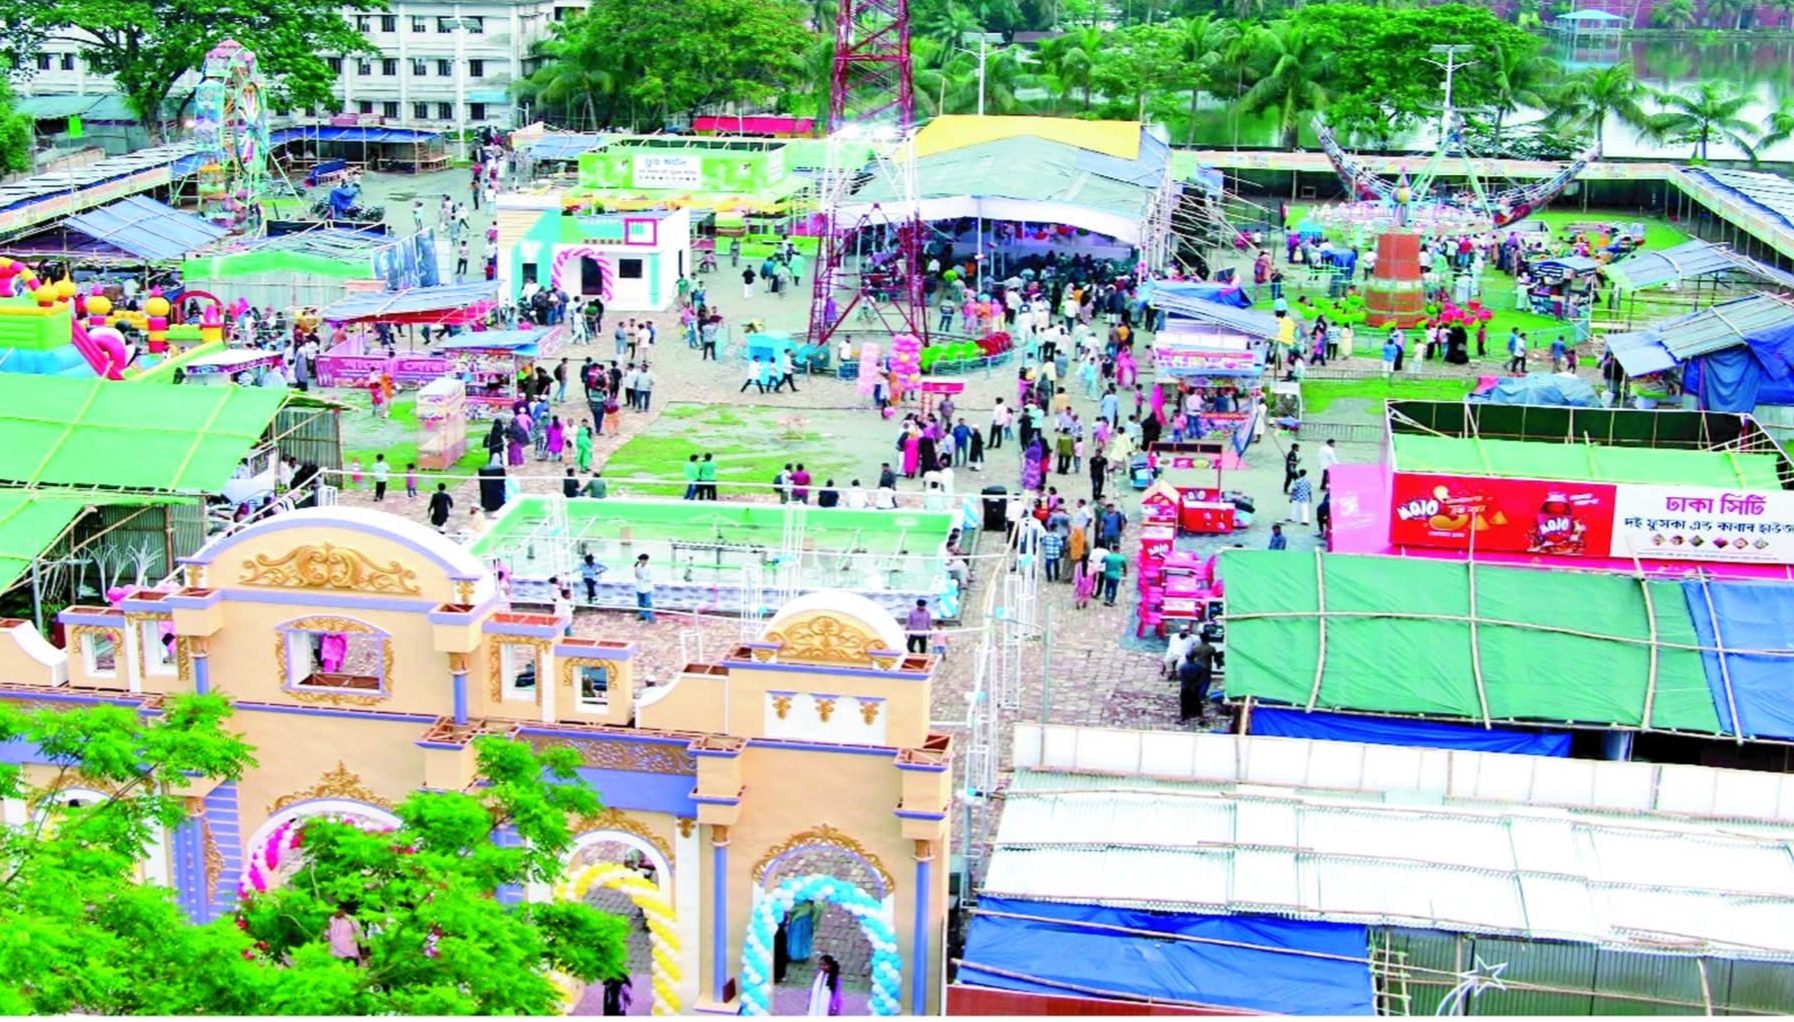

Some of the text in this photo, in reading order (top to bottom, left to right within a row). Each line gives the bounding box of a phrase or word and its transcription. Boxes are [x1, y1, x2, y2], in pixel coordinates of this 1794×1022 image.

[1397, 499, 1440, 520] MOJO
[1665, 493, 1767, 515] ঢাকা সিটি
[1624, 517, 1644, 528] দই
